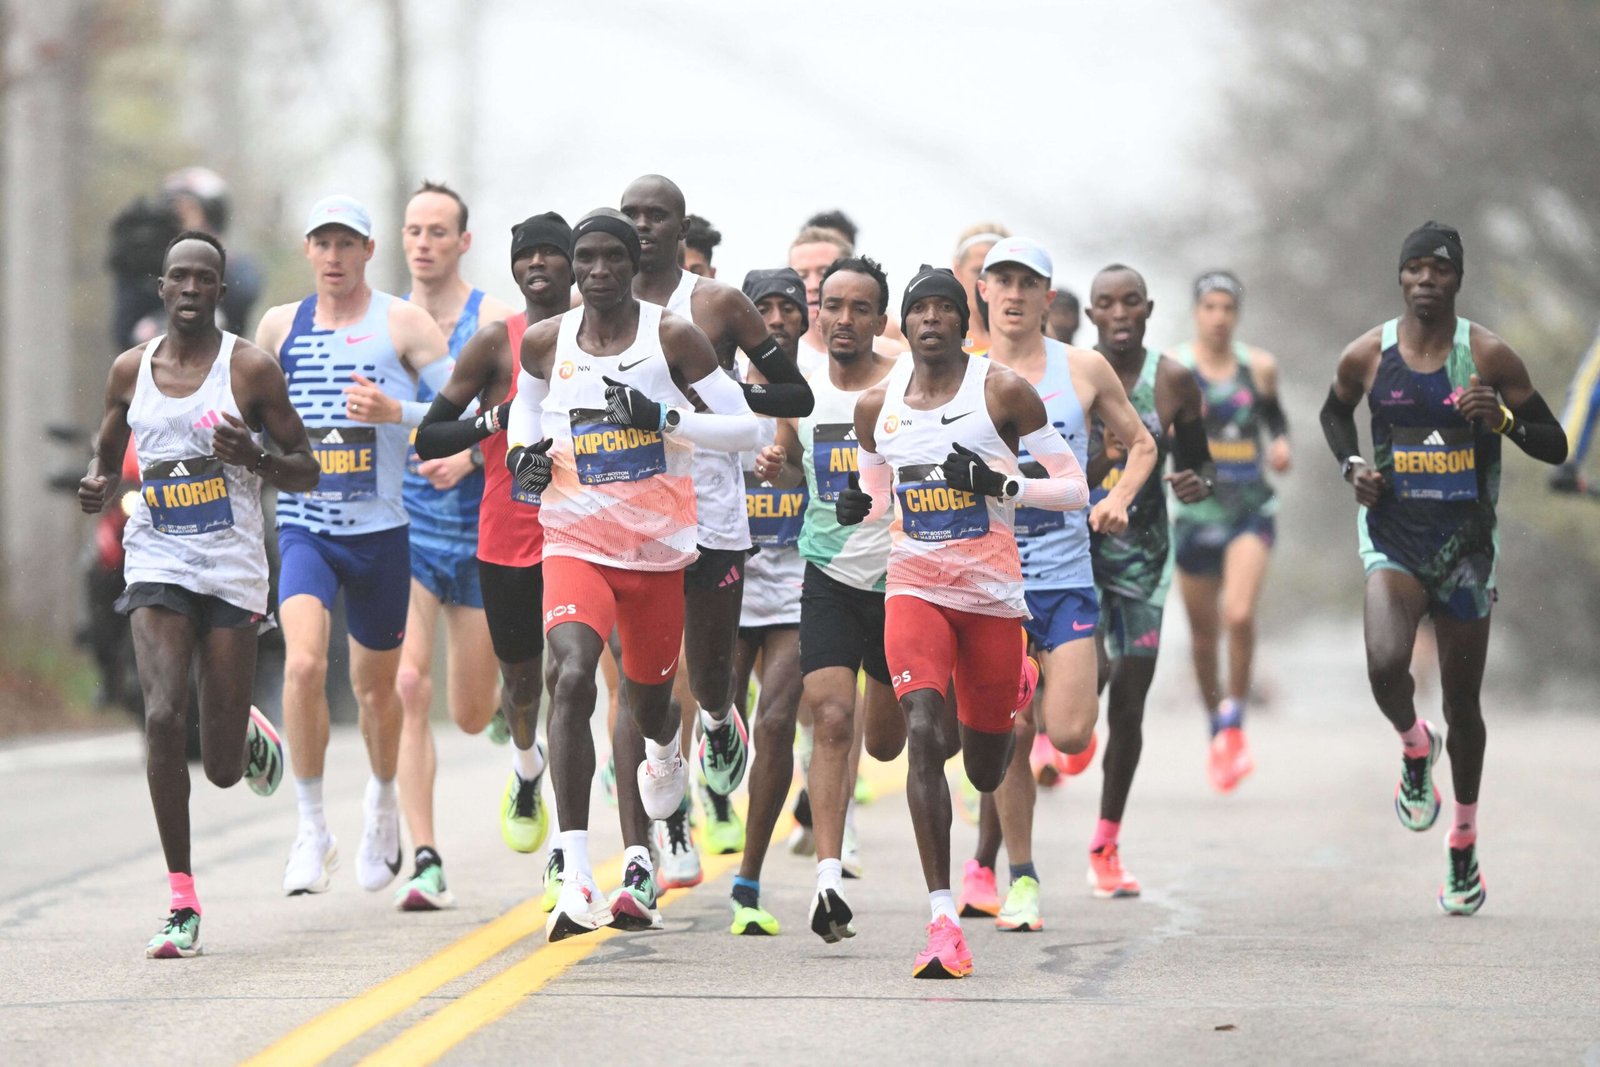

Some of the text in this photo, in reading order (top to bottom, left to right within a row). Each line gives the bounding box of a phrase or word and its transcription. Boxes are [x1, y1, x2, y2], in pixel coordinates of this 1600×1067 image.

[1393, 448, 1476, 474] BENSON
[596, 475, 630, 483] MARATHON
[145, 476, 228, 509] A KORIR
[745, 493, 804, 518] BELAY
[905, 487, 977, 513] CHOGE
